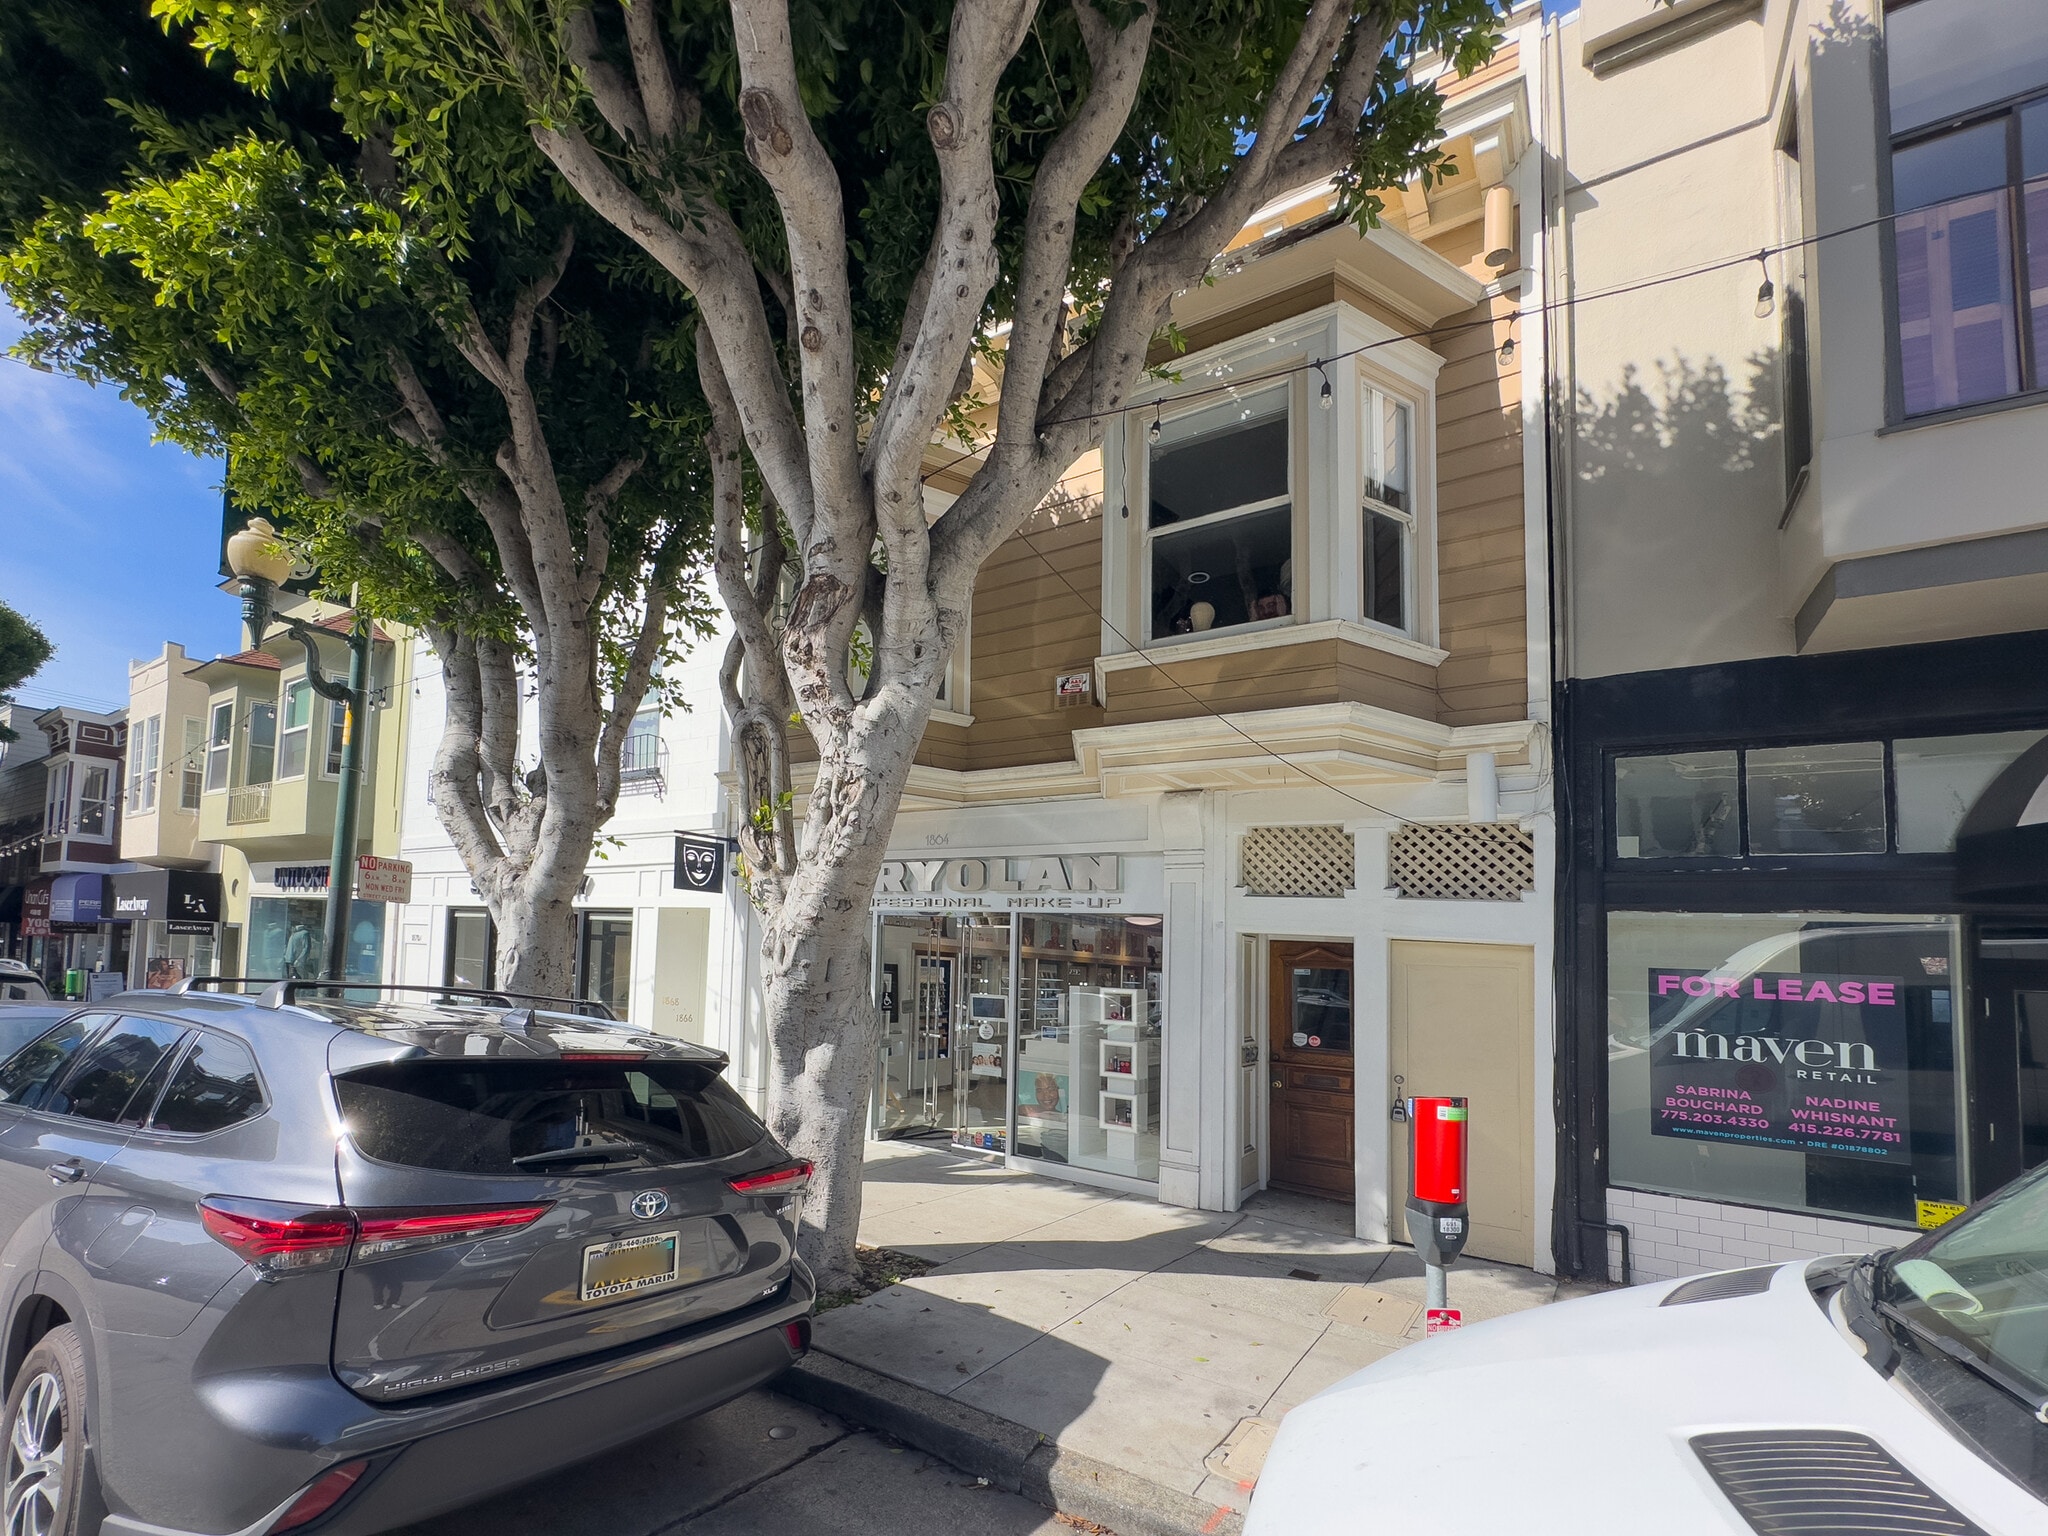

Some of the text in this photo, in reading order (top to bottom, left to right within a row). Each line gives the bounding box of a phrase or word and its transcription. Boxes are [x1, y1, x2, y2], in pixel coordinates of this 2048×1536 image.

[361, 856, 410, 874] NO PARKING
[874, 854, 1122, 893] RYOLAN
[365, 882, 379, 891] MON
[381, 885, 394, 893] WED
[116, 895, 150, 917] LaserAway
[872, 896, 1122, 909] FESSIONAL MAKE-UP
[27, 918, 50, 928] YOG
[169, 924, 211, 932] LaserAway
[1658, 975, 1896, 1006] FOR LEASE
[675, 1013, 693, 1023] 1866
[1672, 1030, 1881, 1072] maven
[1796, 1070, 1877, 1085] RETAIL
[1675, 1084, 1752, 1100] SABRINA
[1665, 1097, 1763, 1115] BOUCHARD
[1805, 1096, 1880, 1112] NADINE
[1661, 1109, 1770, 1129] 775.203.4330
[1791, 1108, 1897, 1129] WHISNANT
[1672, 1126, 1796, 1146] www.mavenproperties.com
[1807, 1140, 1828, 1149] DRE
[1788, 1122, 1901, 1143] 415.226.7781
[586, 1273, 675, 1300] TOYOTA MARIN
[383, 1359, 521, 1394] HIGHLANDER
